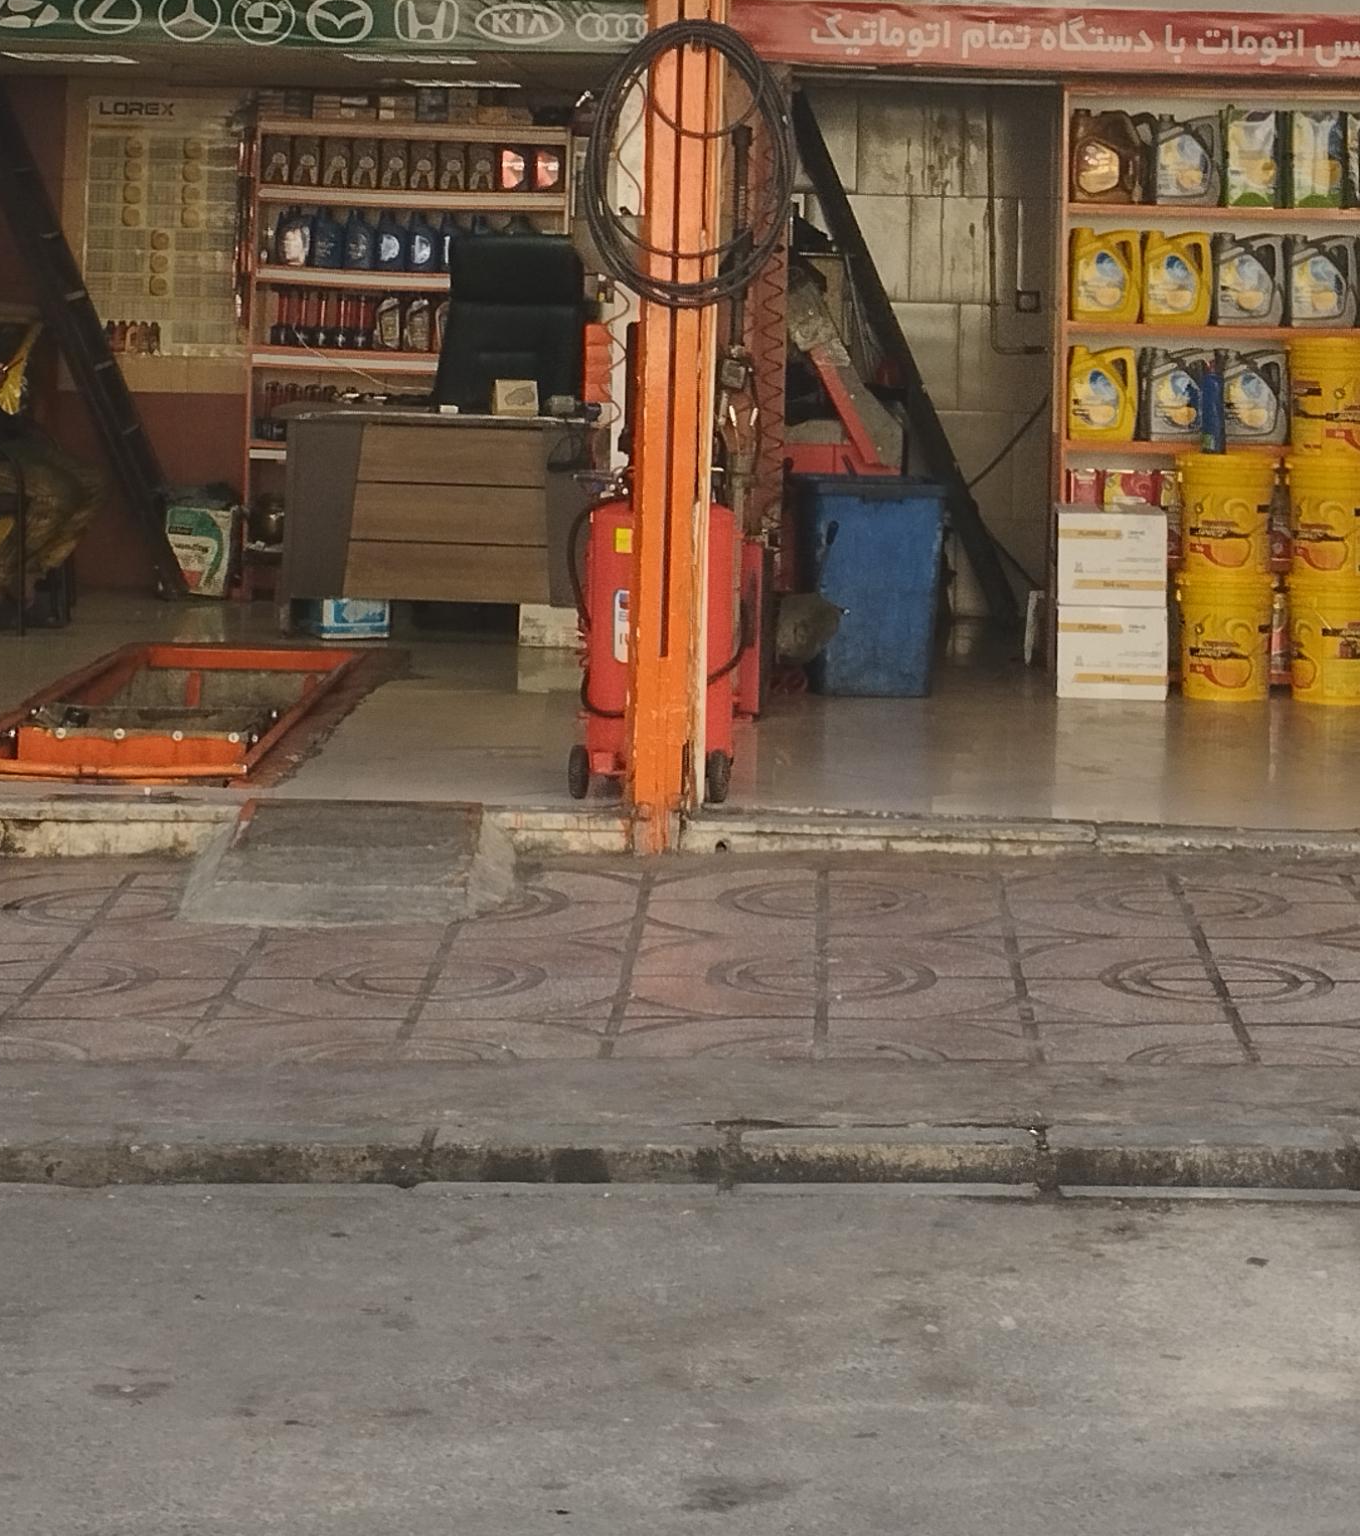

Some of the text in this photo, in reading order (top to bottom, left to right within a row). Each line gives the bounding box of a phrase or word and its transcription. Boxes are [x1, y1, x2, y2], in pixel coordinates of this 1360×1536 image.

[810, 14, 952, 57] اتوماتیک
[961, 20, 1033, 59] تمام
[1040, 15, 1155, 54] دستگاه
[1164, 24, 1187, 64] با
[1197, 26, 1305, 67] اتومات
[98, 101, 176, 117] LOREX
